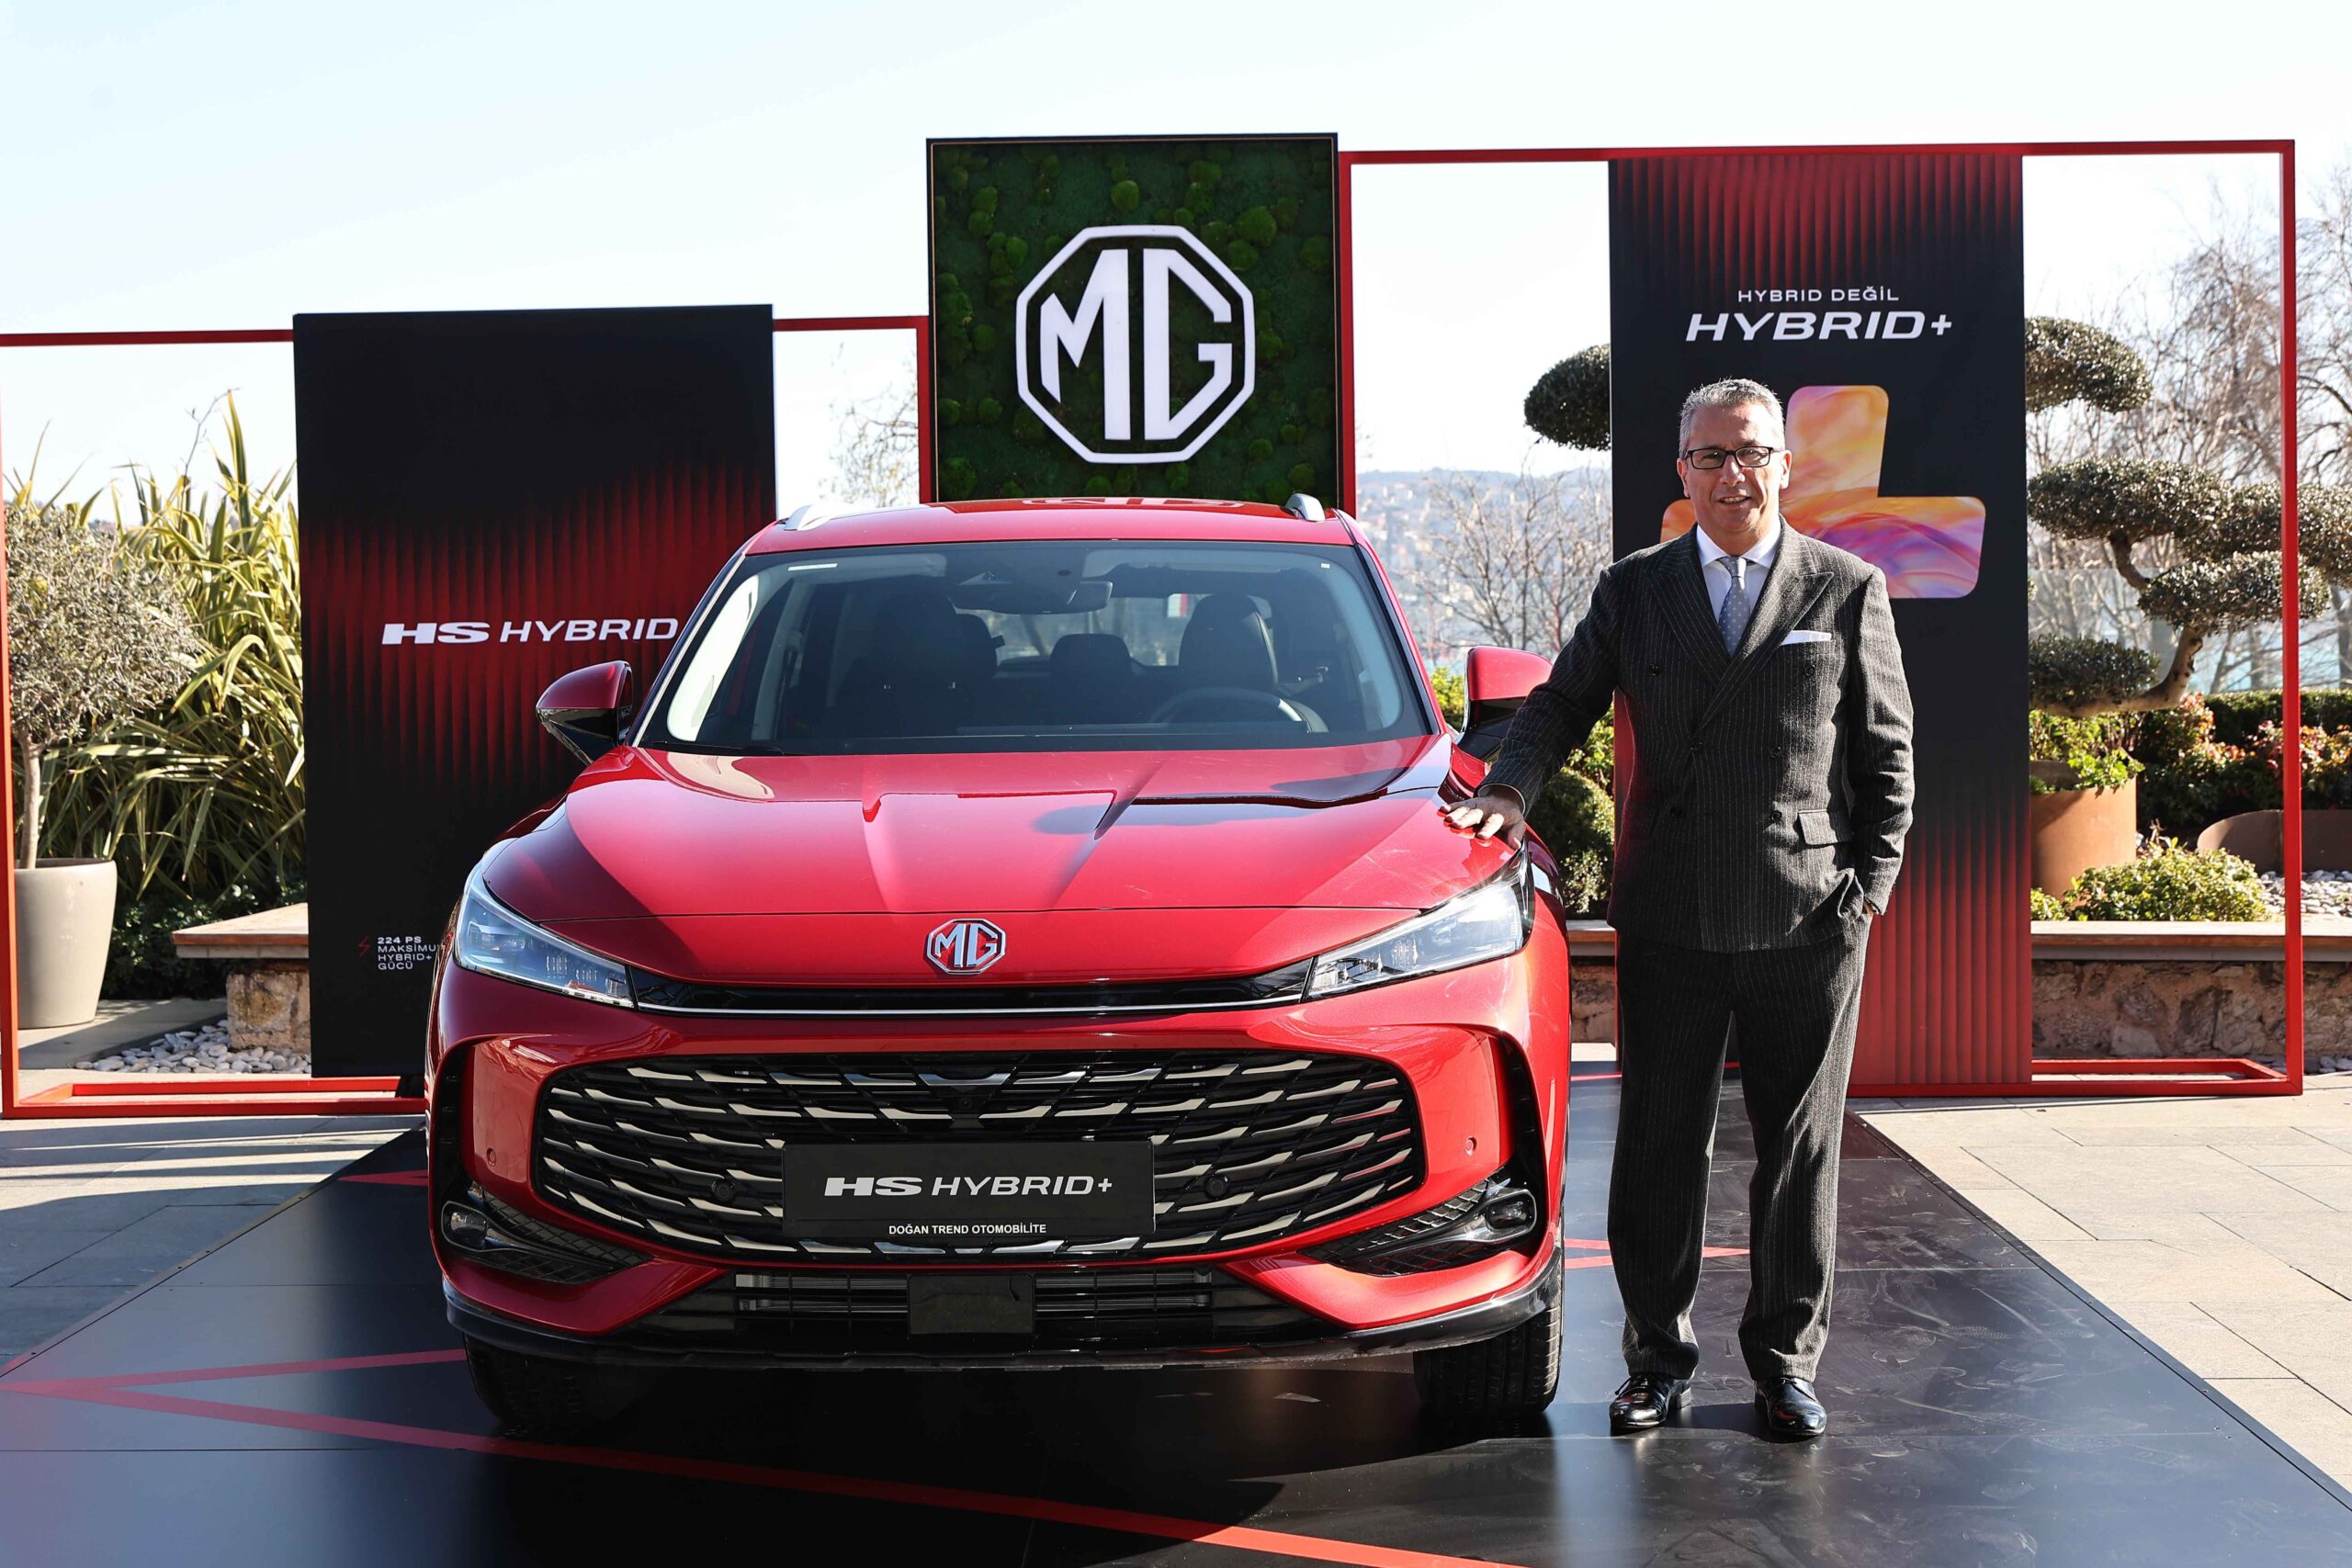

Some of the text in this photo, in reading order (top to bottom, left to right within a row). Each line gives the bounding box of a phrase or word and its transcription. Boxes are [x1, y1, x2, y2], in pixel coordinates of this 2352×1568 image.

[1738, 286, 1899, 302] HYBRID DEĞİL
[1686, 310, 1952, 342] HYBRID+
[1039, 248, 1233, 441] MG
[381, 622, 491, 645] HS
[405, 936, 422, 944] PS
[934, 922, 999, 968] MG
[378, 953, 433, 962] HYBRID+
[378, 961, 413, 970] GÜCÜ
[824, 1176, 1114, 1196] HS HYBRID+
[888, 1223, 1047, 1235] DOĞAN TREND OTOMOBİLİTE
